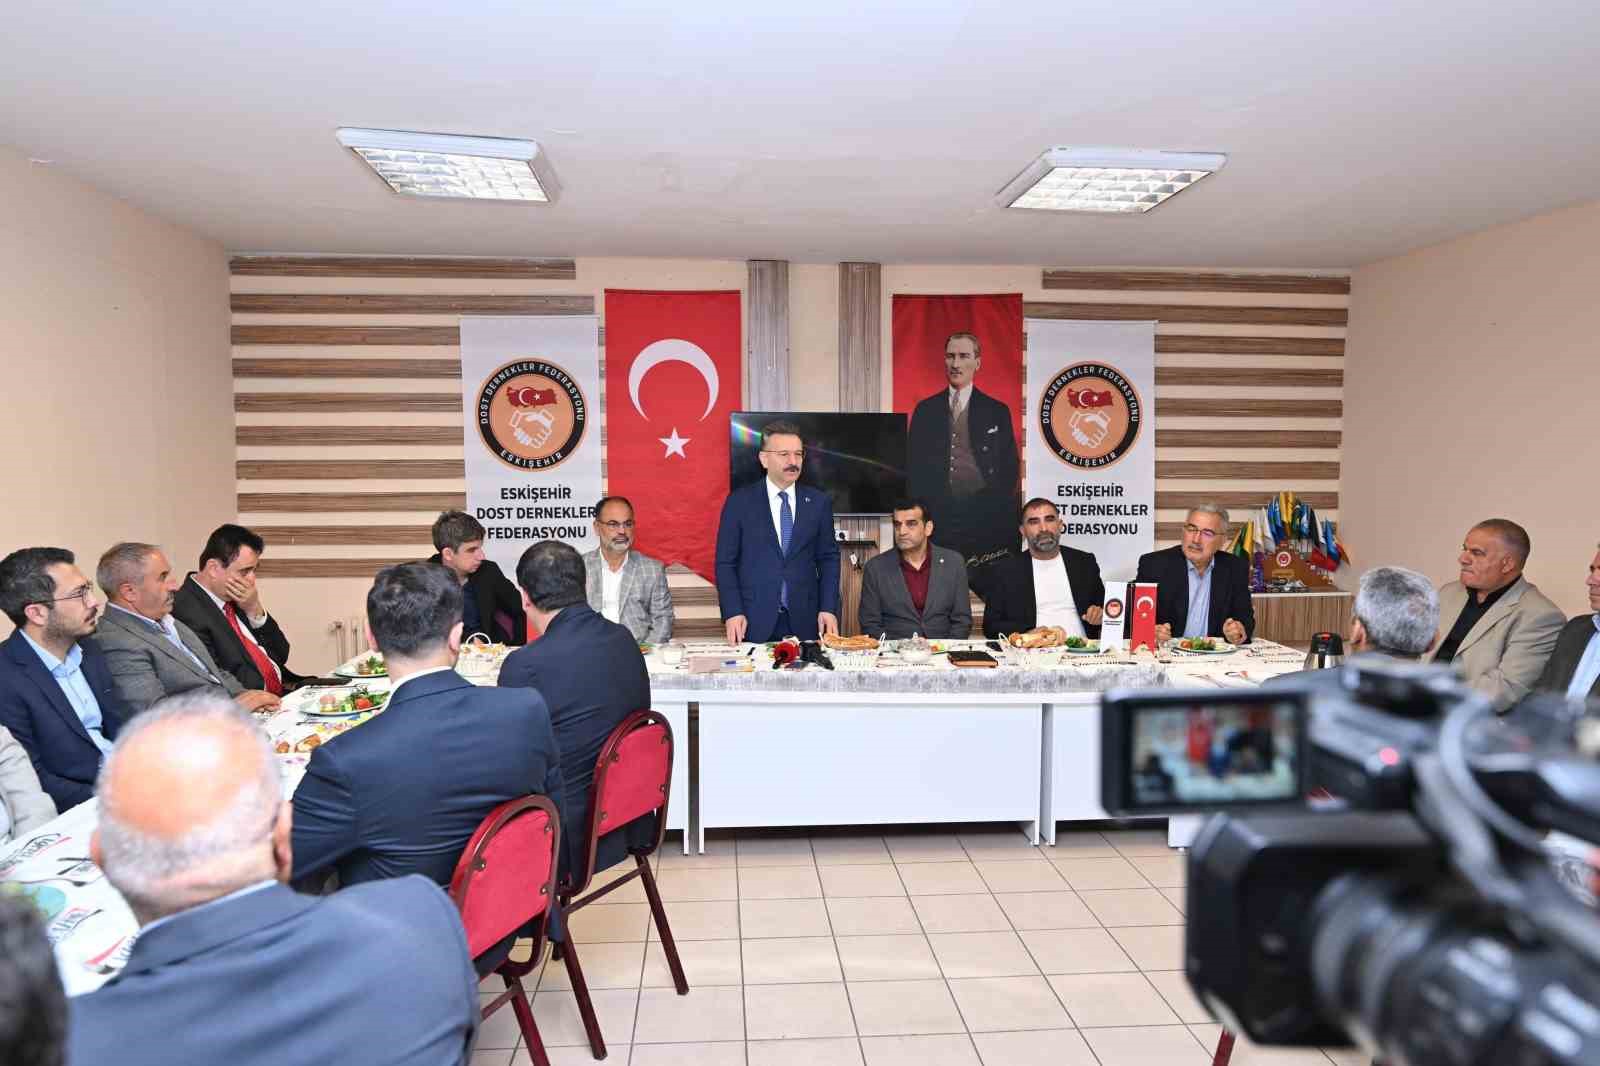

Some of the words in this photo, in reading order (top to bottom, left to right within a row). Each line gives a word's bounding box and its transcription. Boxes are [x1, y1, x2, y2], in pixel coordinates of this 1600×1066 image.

[480, 398, 489, 424] DOST
[500, 484, 571, 503] ESKİŞEHİR
[1057, 482, 1124, 501] ESKİŞEHİR
[476, 507, 513, 519] DOST
[516, 506, 597, 519] DERNEKLER
[1071, 504, 1148, 516] DERNEKLER
[487, 526, 587, 539] FEDERASYONU
